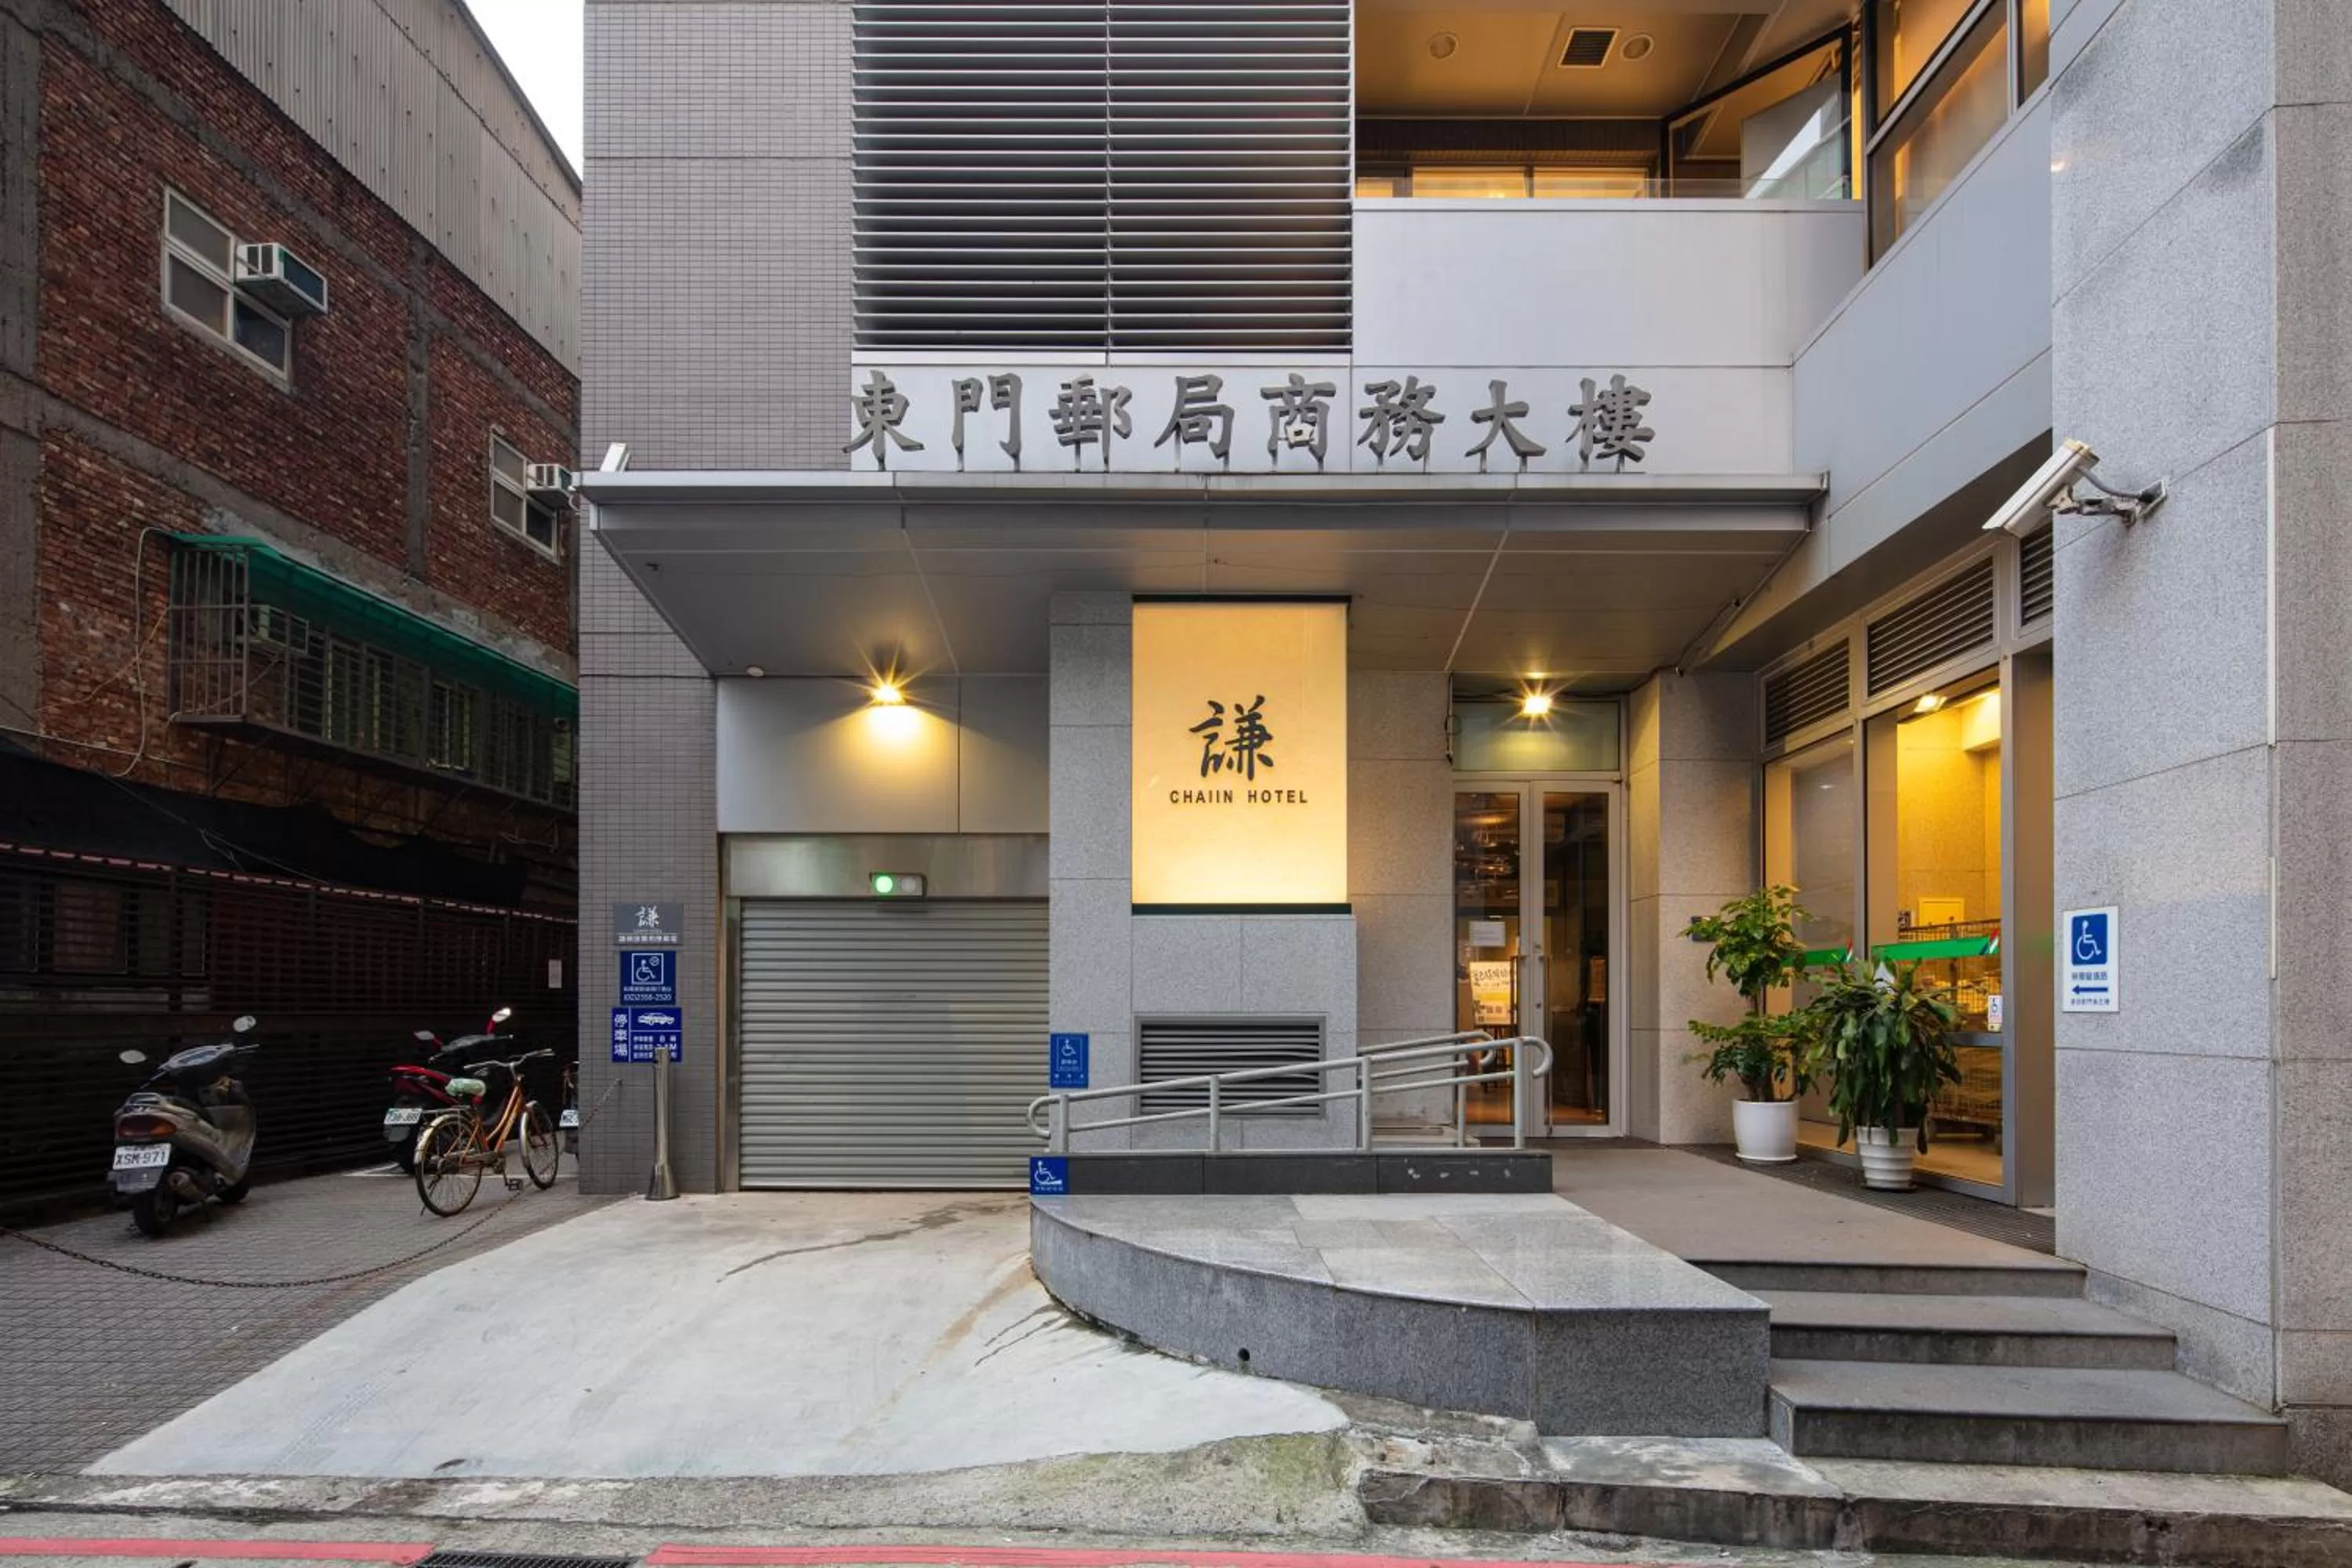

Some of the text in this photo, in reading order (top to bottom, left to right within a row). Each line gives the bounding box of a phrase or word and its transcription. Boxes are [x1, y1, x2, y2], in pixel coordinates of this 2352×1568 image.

[843, 370, 1655, 463] 東門郵局商務大樓
[1188, 694, 1274, 781] 謙
[1170, 789, 1308, 804] CHAIIN HOTEL
[634, 906, 659, 927] 謙
